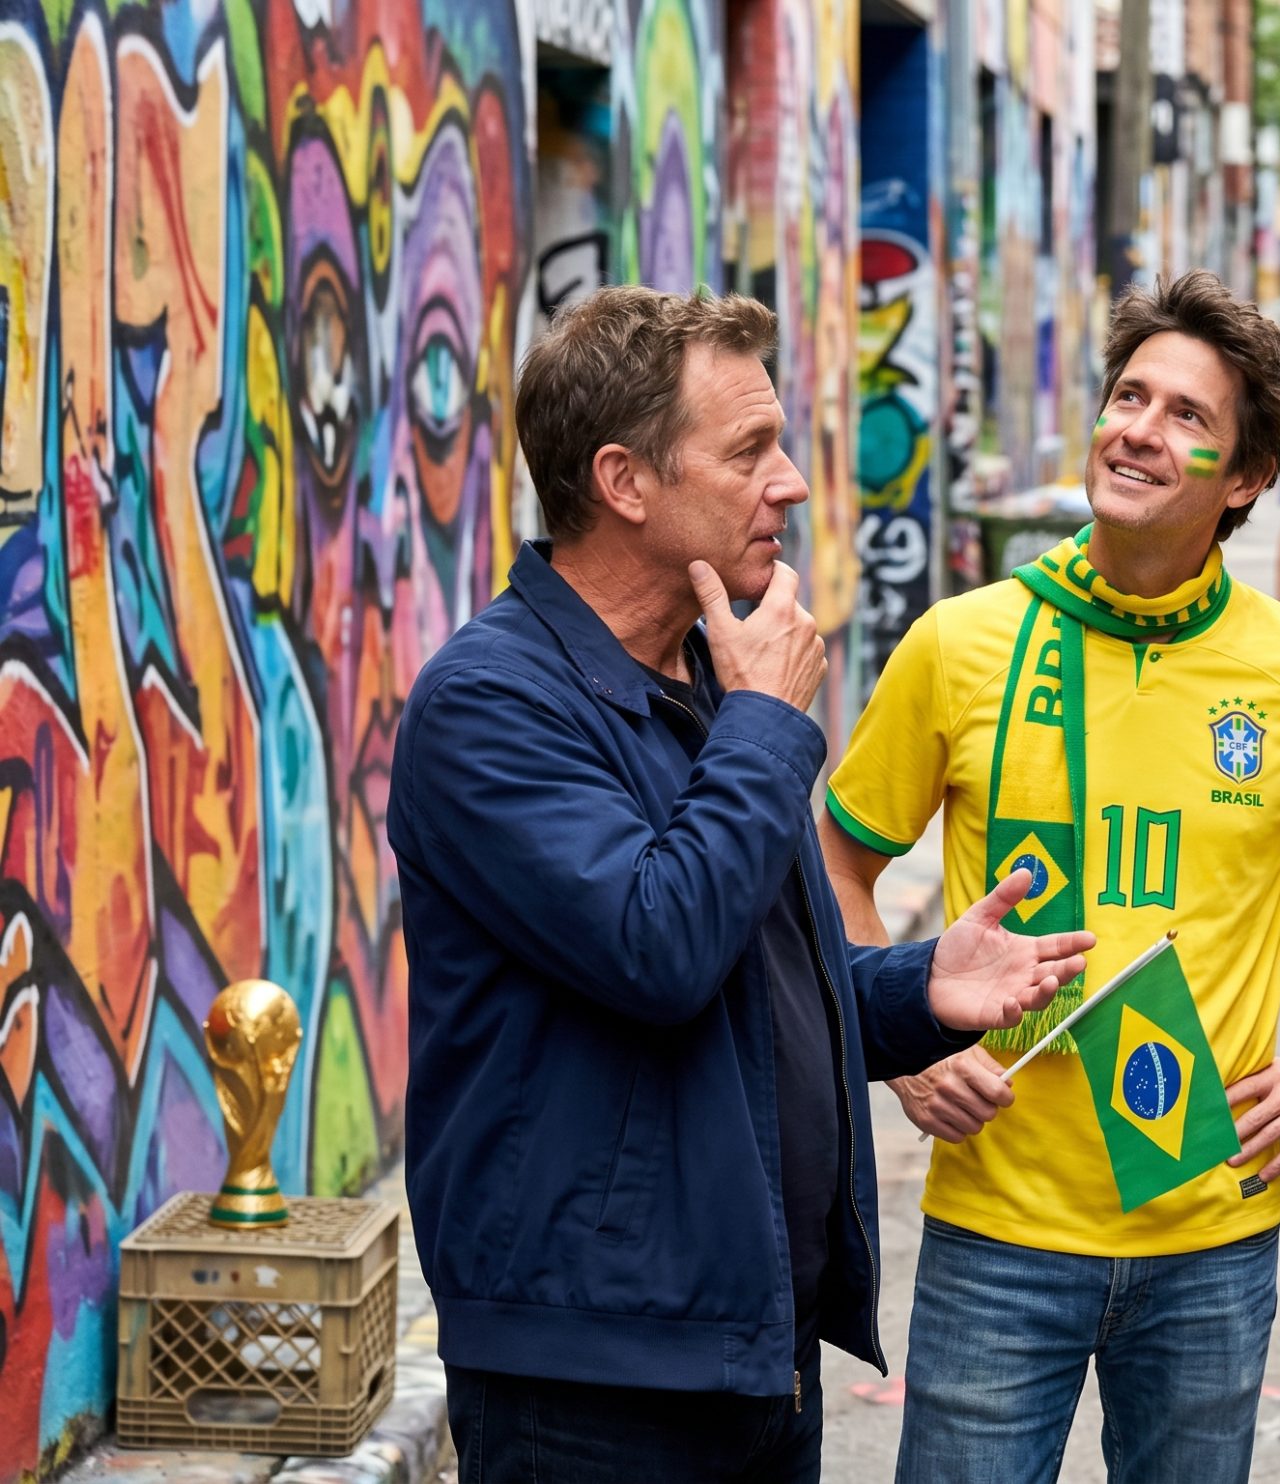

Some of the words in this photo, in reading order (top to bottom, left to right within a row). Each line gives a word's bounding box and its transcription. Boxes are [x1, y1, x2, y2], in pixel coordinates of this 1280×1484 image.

[1229, 742, 1248, 751] CBF
[1211, 789, 1264, 807] BRASIL
[1098, 804, 1181, 911] 10
